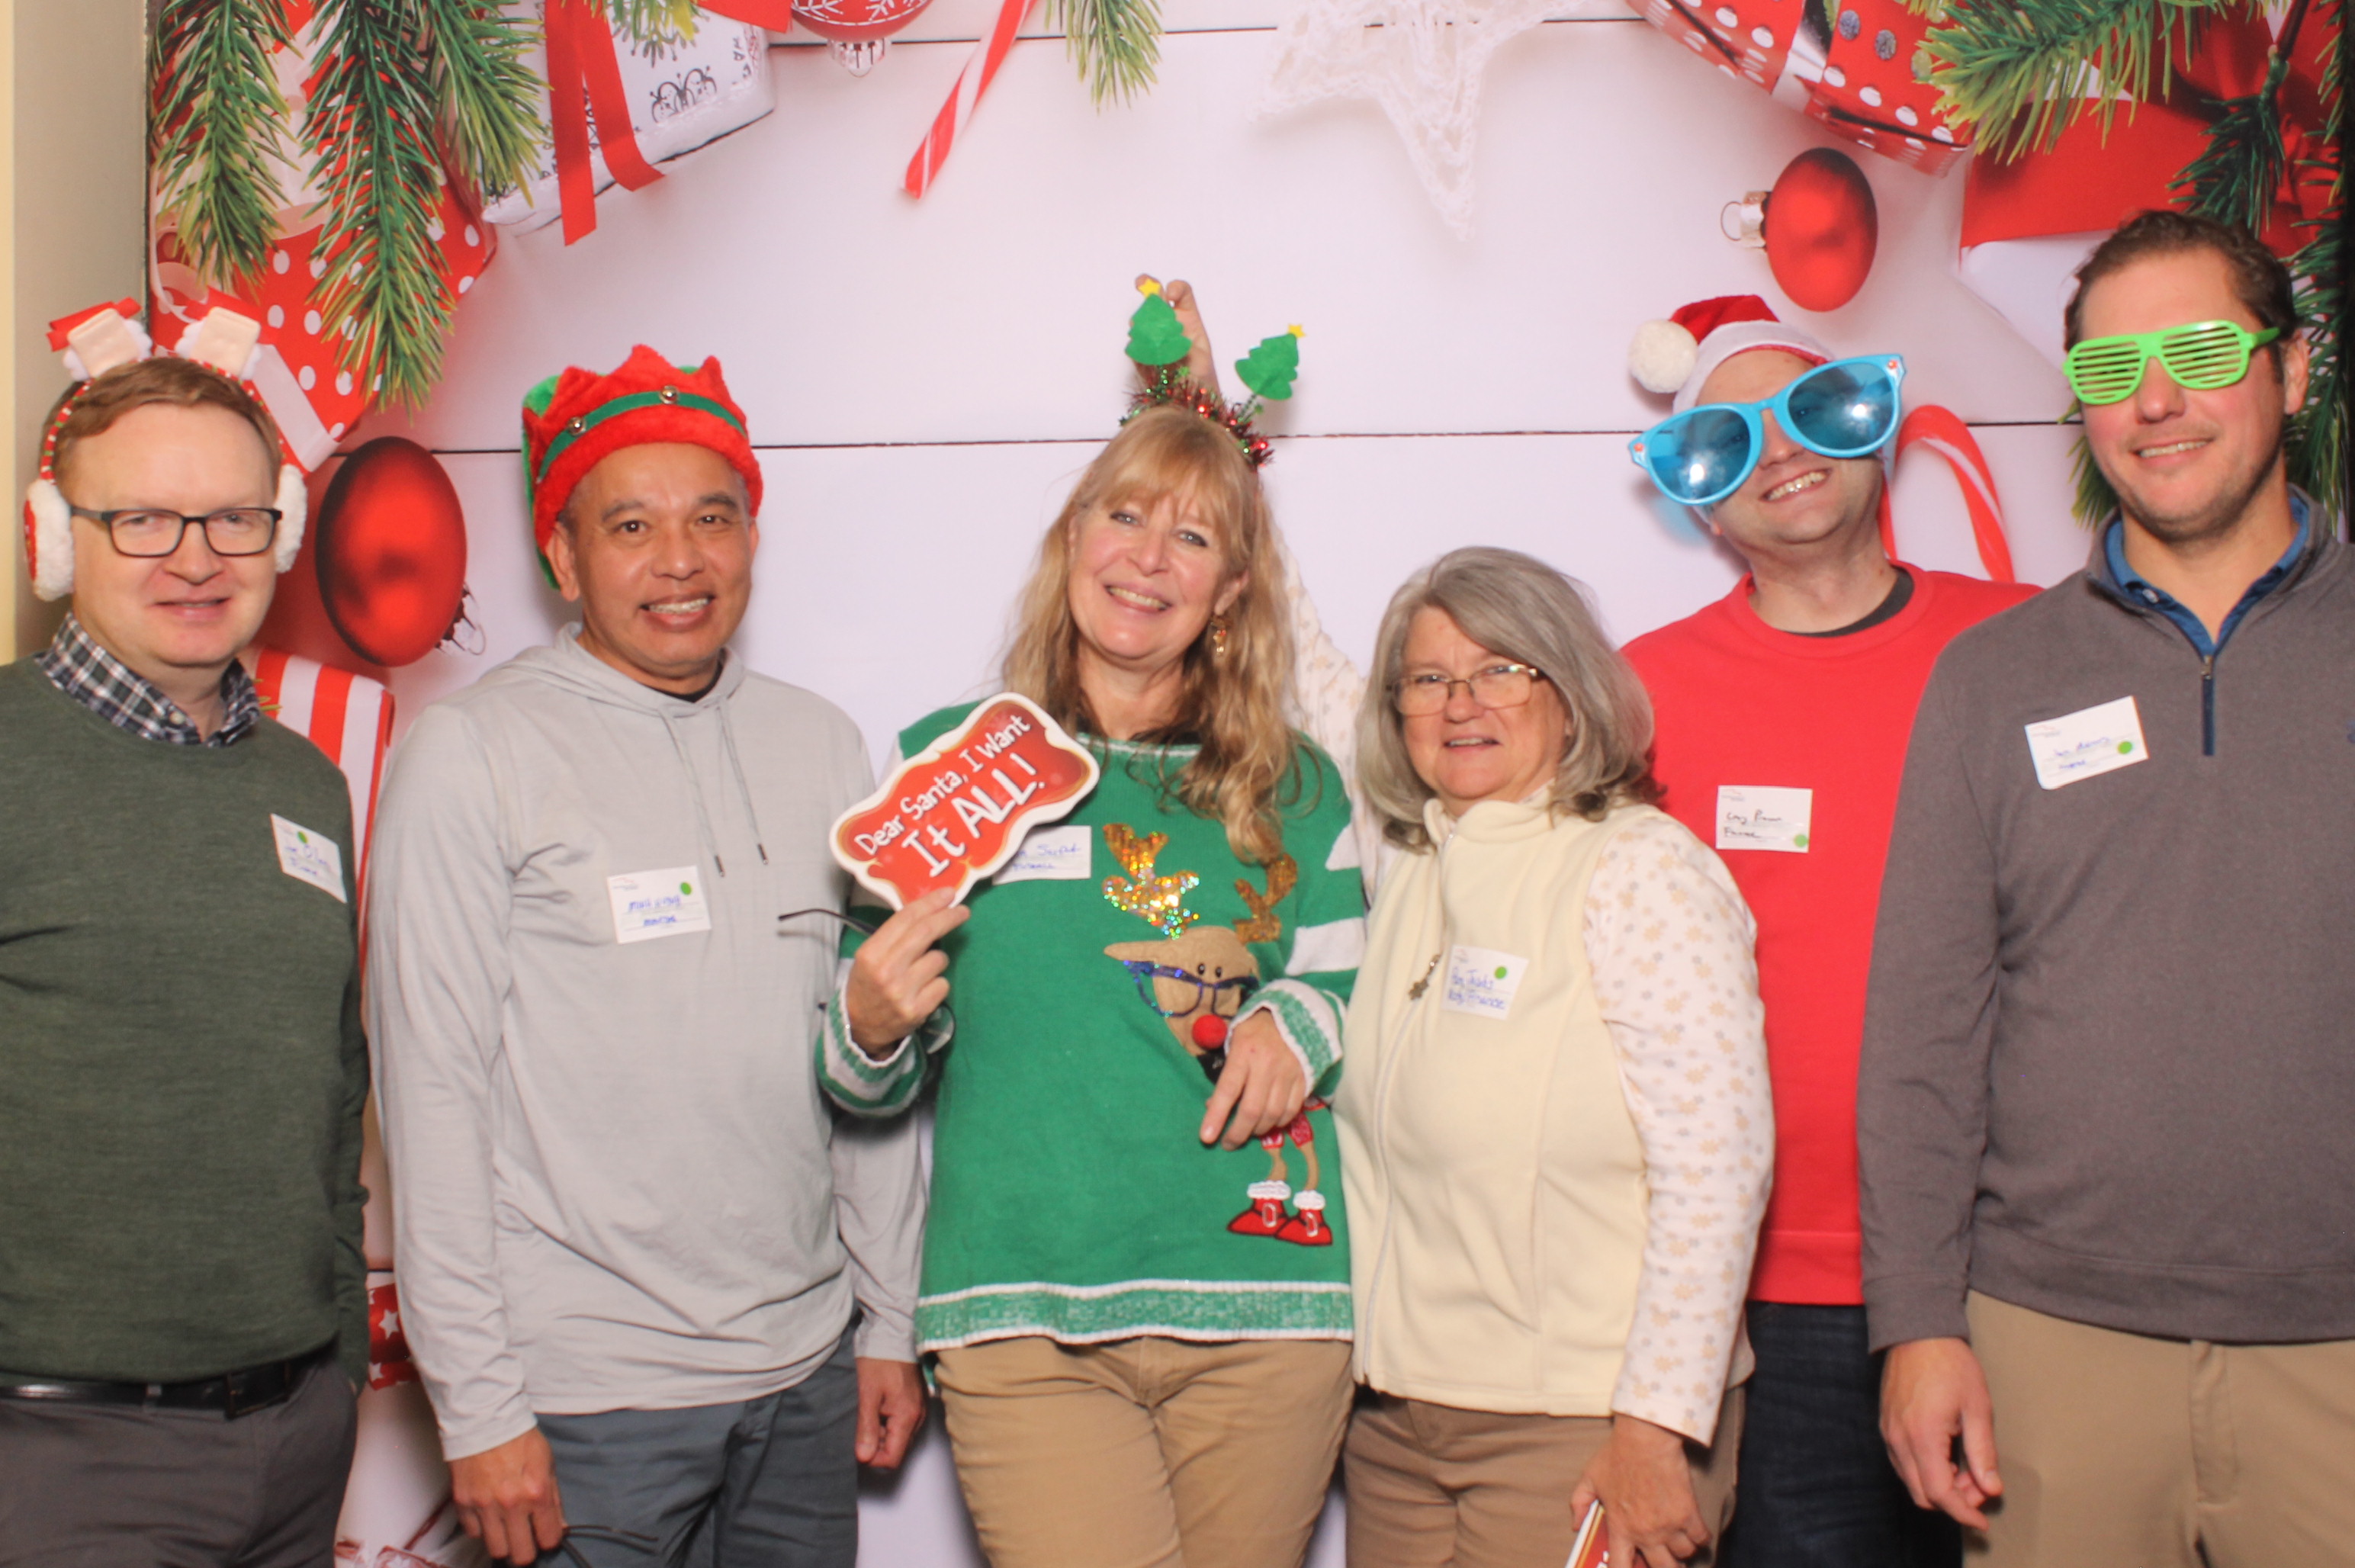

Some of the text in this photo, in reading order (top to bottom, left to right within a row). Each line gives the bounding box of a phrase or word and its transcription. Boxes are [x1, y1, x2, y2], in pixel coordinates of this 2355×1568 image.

[854, 714, 1031, 855] Dear Santa, I Want
[901, 753, 1046, 878] It ALL!
